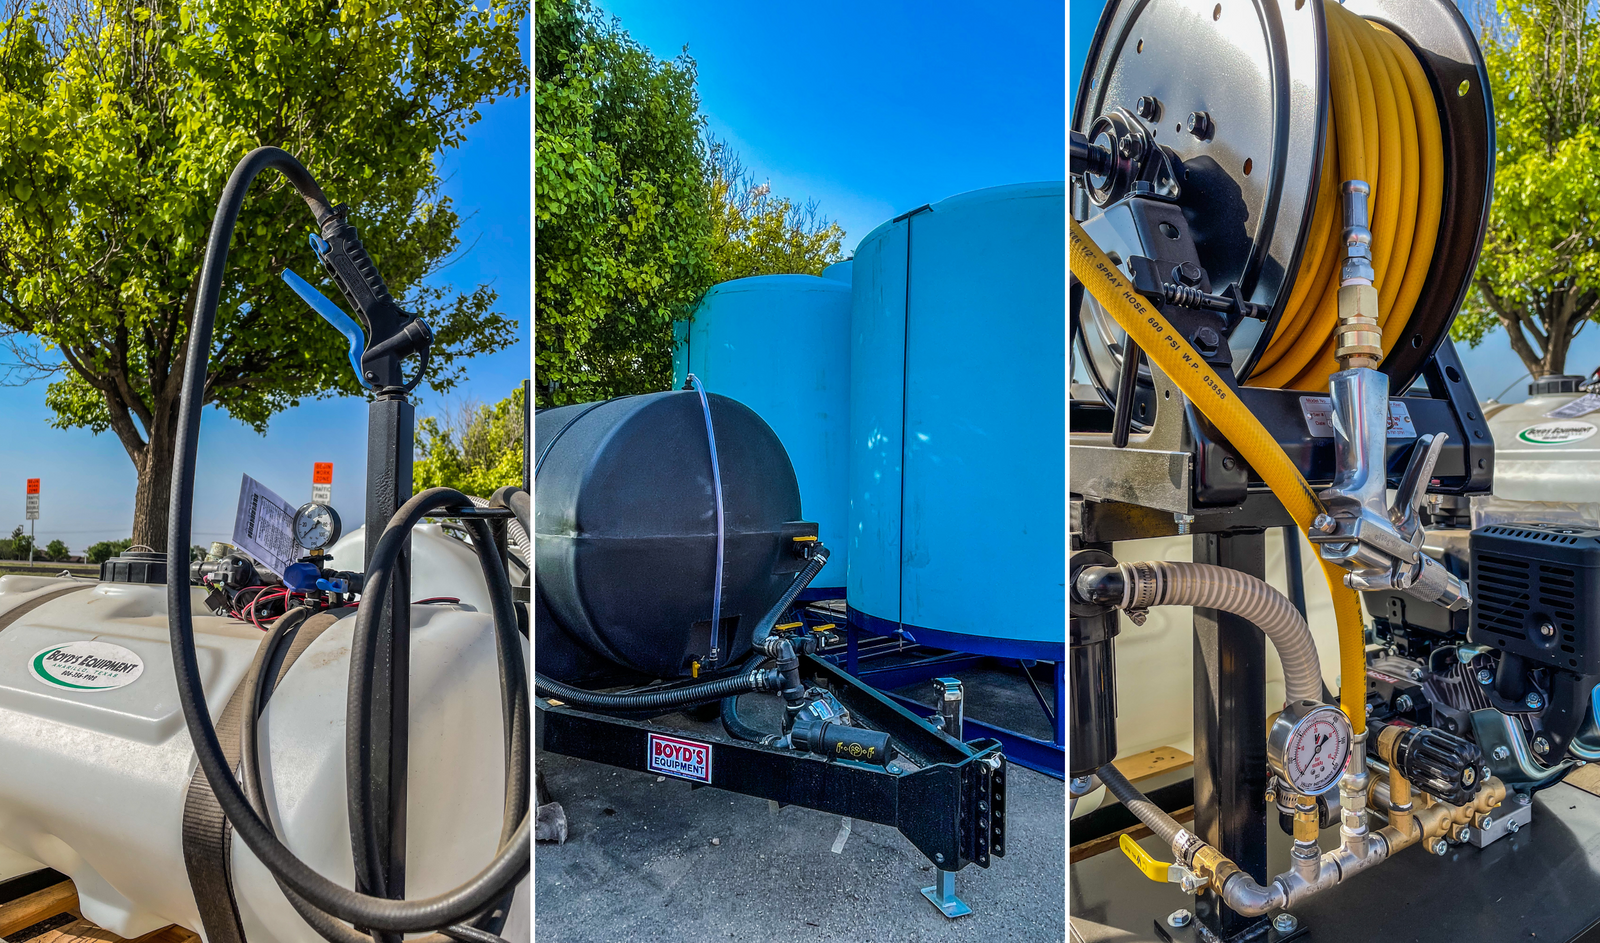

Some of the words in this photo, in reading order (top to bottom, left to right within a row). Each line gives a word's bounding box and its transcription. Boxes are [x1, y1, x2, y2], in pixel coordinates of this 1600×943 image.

[1097, 262, 1123, 288] SPRAY
[1123, 291, 1147, 315] HOSE
[1148, 317, 1163, 333] 600
[1165, 335, 1180, 351] PSI
[1182, 352, 1198, 373] W.P.
[1204, 375, 1226, 400] 03856
[46, 650, 83, 665] BOYD'S
[78, 655, 138, 673] EQUIPMENT
[52, 663, 89, 673] AMARILLO,
[94, 670, 118, 678] TEXAS
[655, 741, 704, 765] BOYD'S
[654, 757, 704, 774] EQUIPMENT
